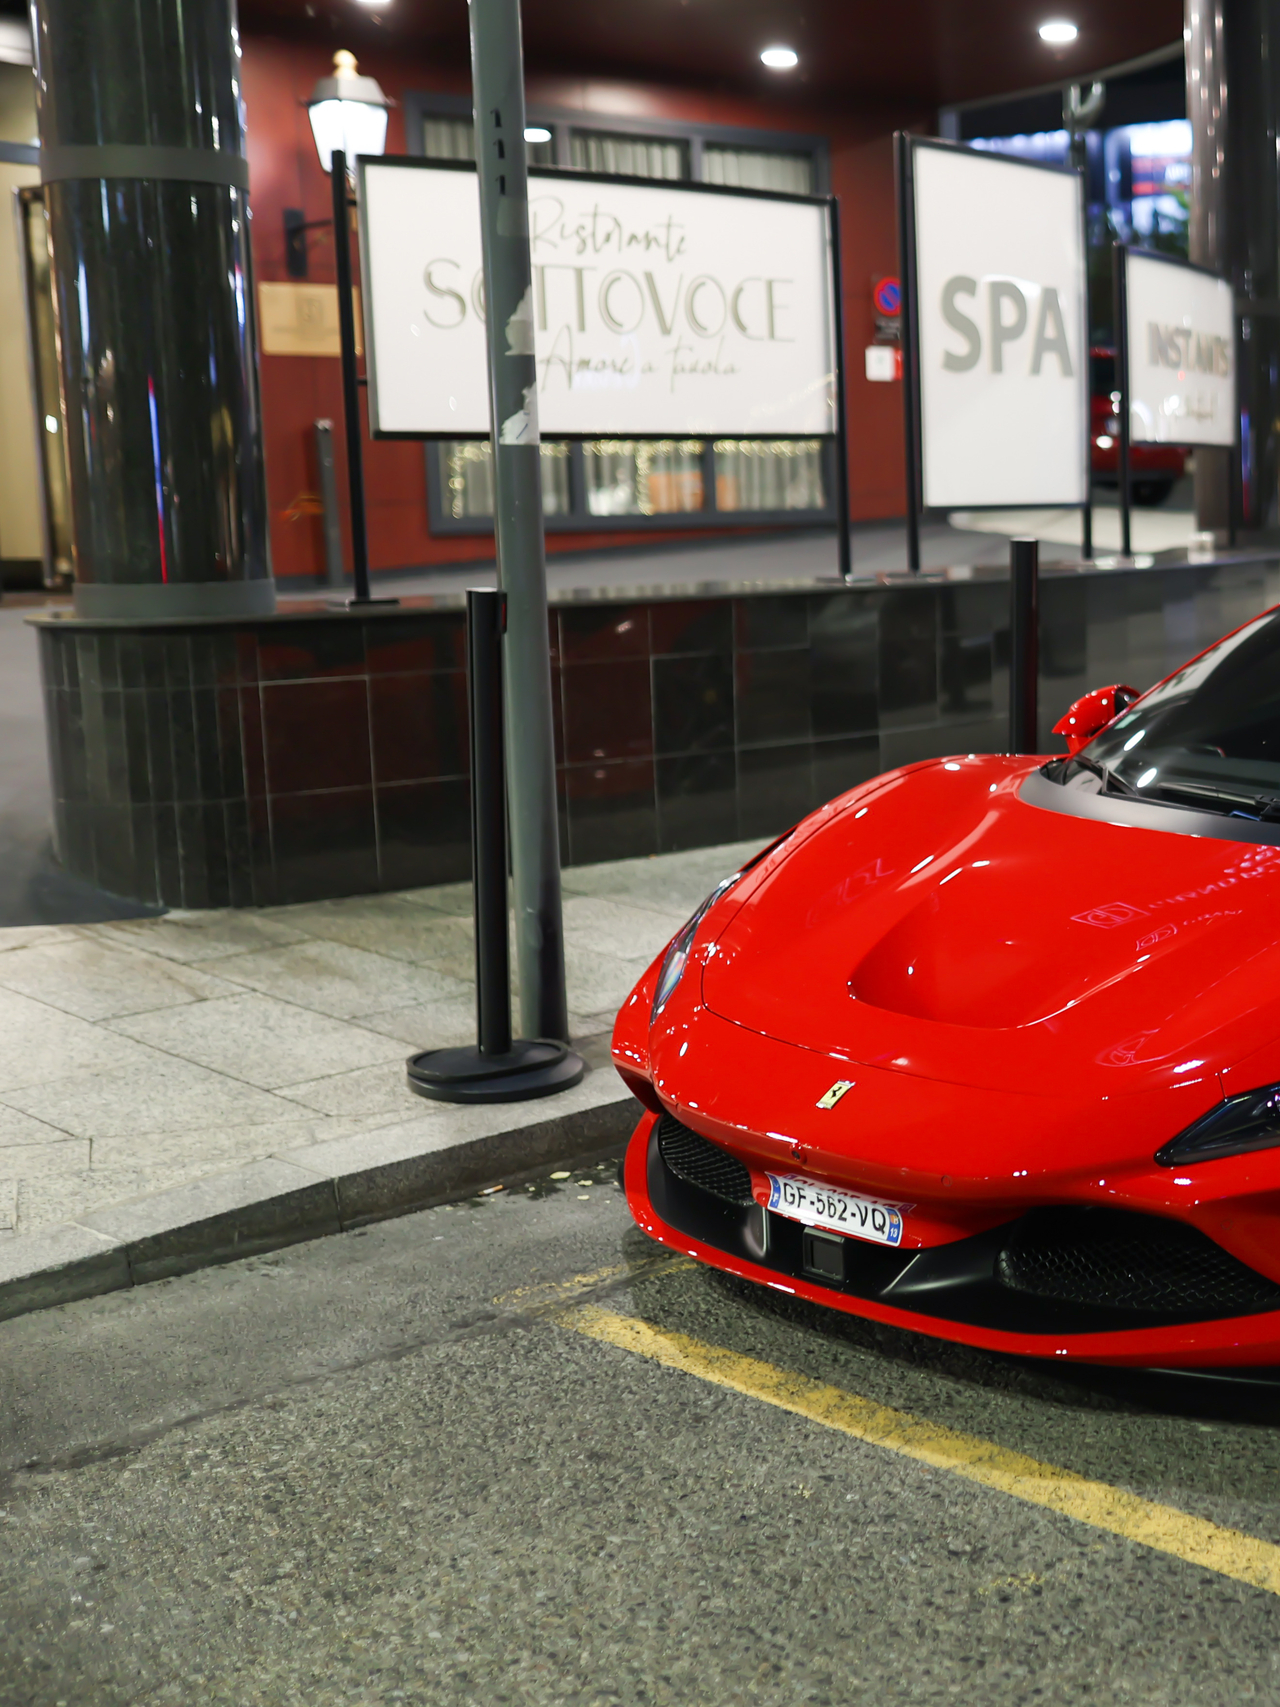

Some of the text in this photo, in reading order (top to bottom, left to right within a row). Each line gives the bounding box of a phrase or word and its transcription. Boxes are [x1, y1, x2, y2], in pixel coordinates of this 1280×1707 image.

[527, 195, 687, 263] Ristorante
[536, 324, 634, 391] Amore
[941, 275, 1074, 378] SPA
[772, 1182, 898, 1238] F GF-562-VQ 13
